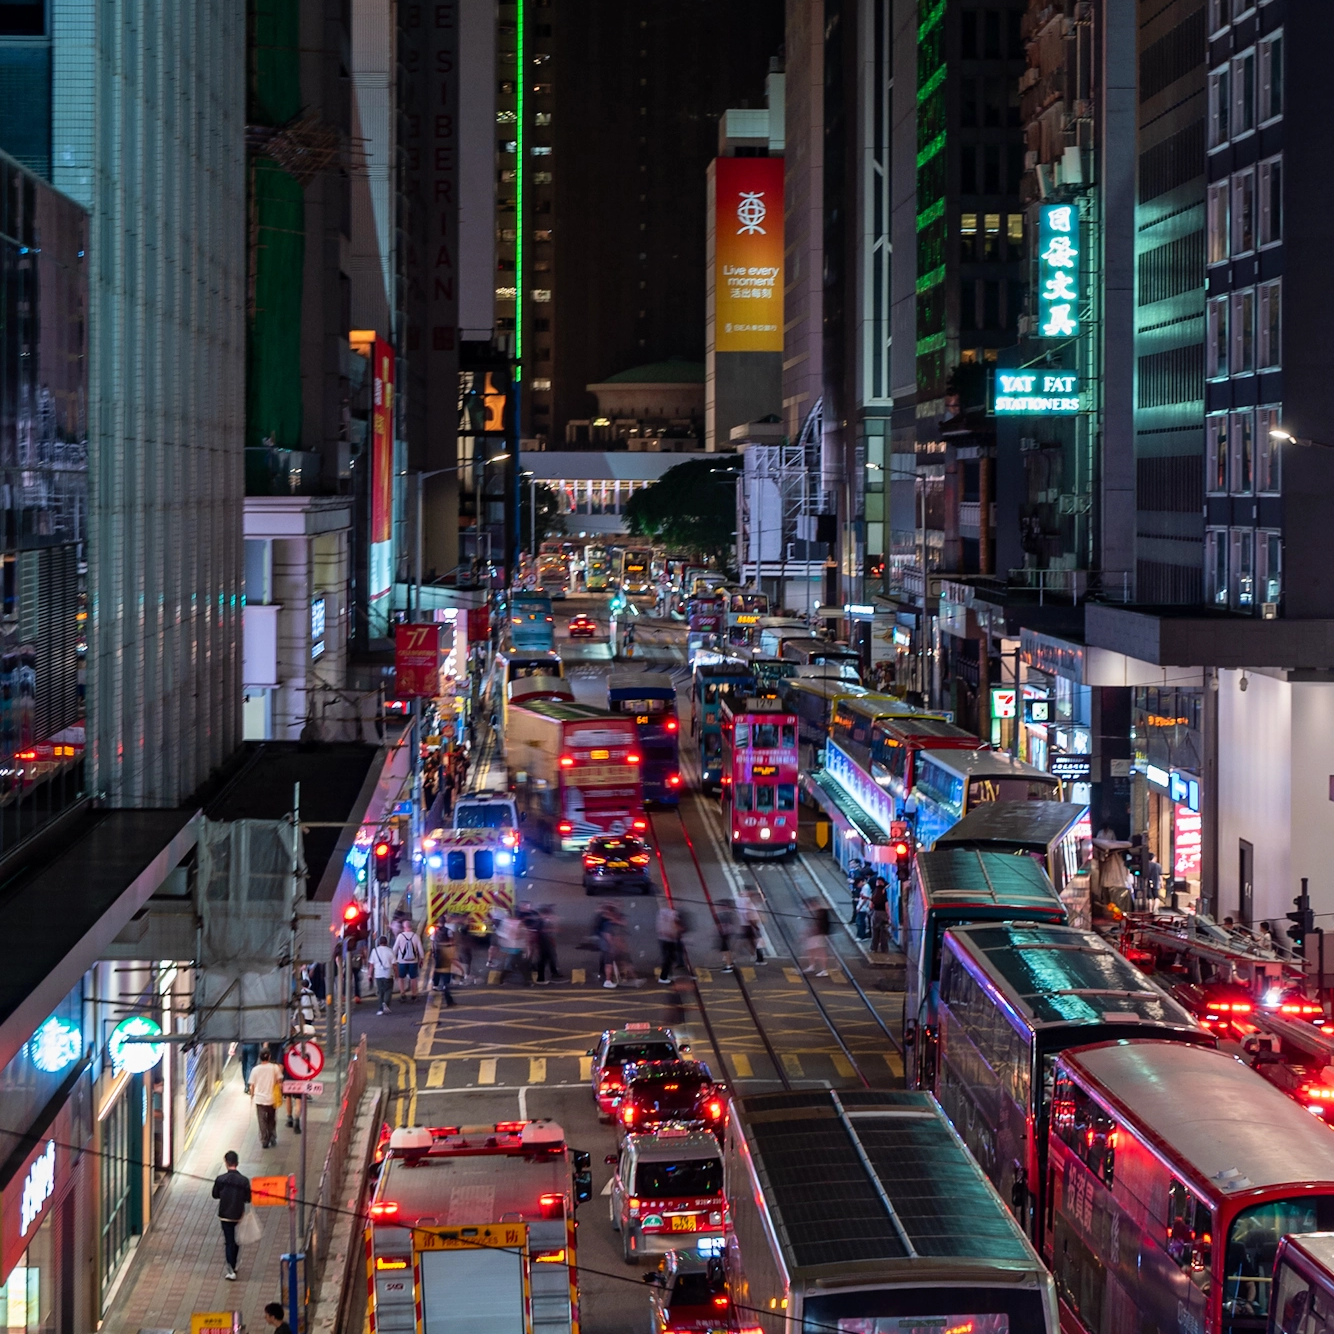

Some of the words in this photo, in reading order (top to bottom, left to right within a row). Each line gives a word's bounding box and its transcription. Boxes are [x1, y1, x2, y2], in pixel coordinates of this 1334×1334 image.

[434, 50, 453, 301] SIBERIAN
[722, 264, 747, 276] Live
[747, 266, 780, 278] every
[1041, 206, 1078, 336] 日發文具
[727, 277, 776, 286] moment
[730, 287, 773, 299] 活出每刻
[1000, 375, 1036, 393] YAT
[1043, 375, 1076, 393] FAT
[995, 397, 1080, 411] STATIONERS
